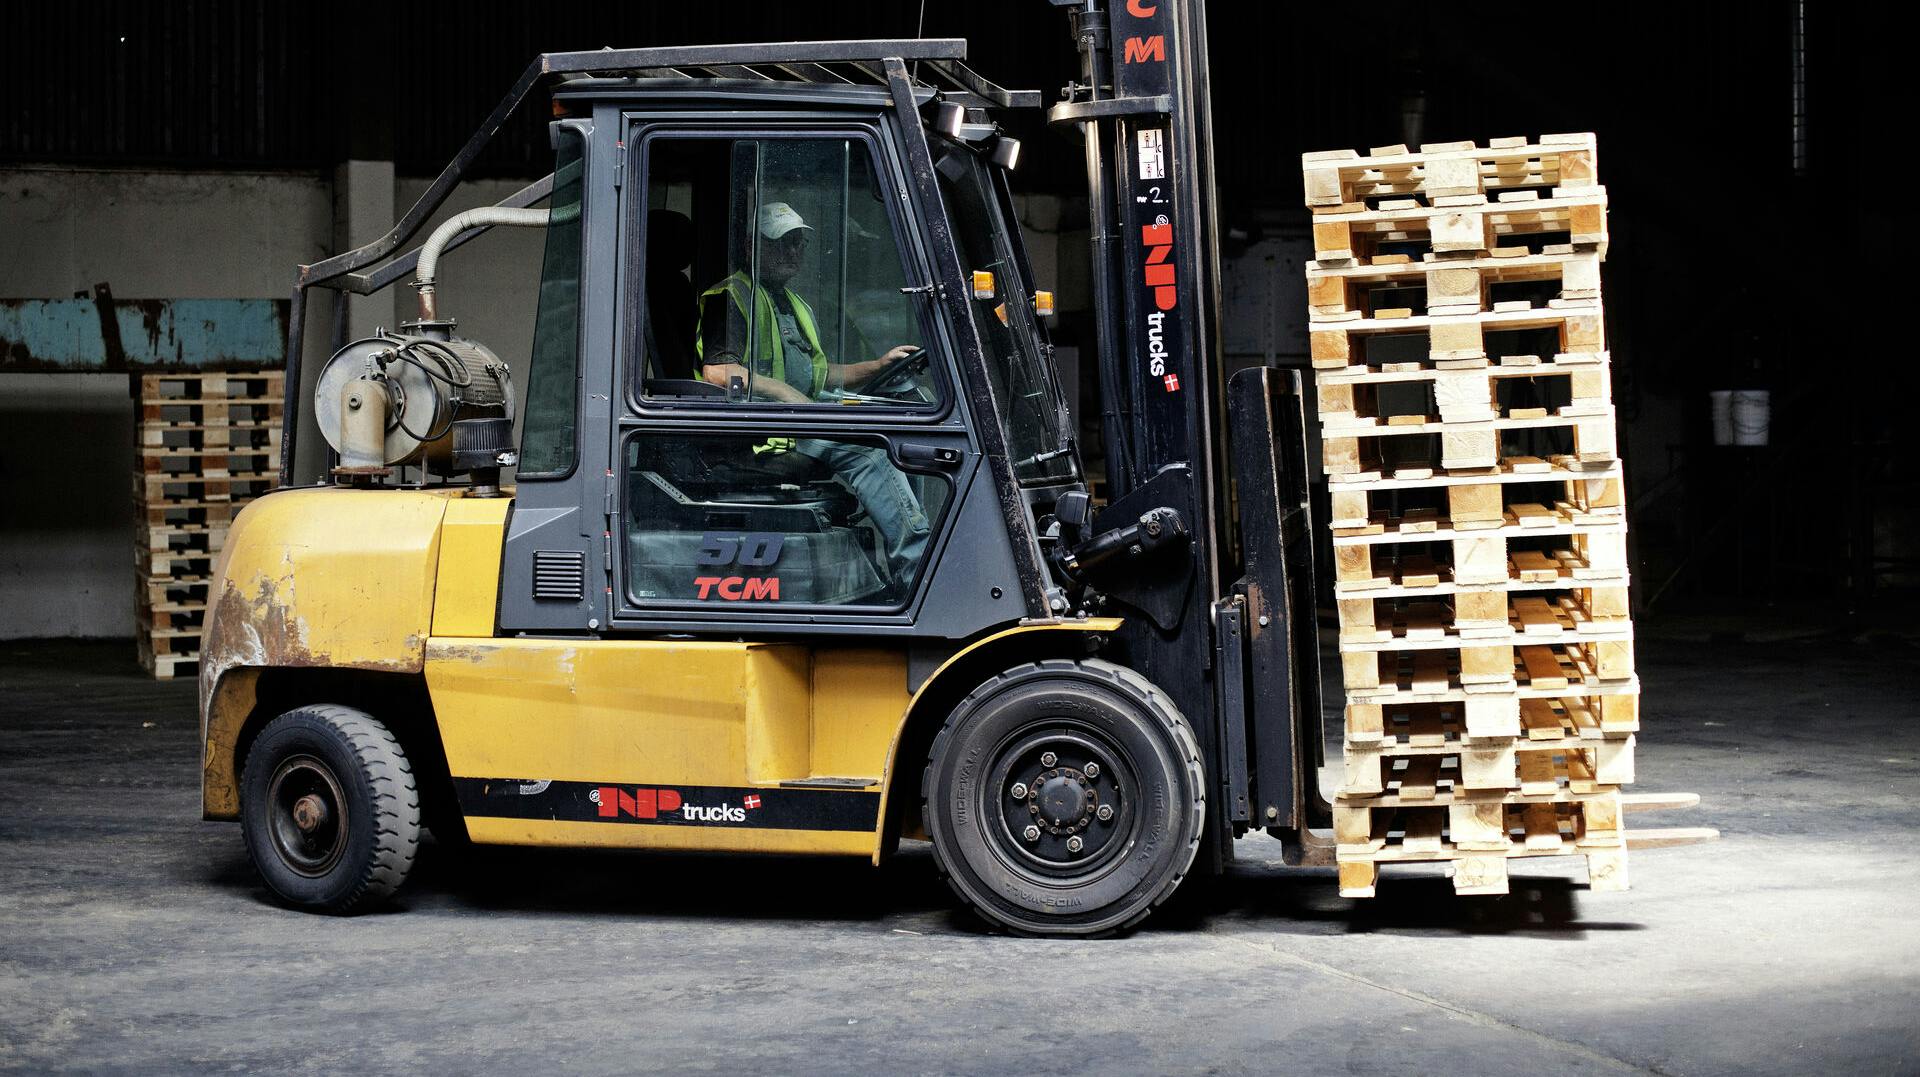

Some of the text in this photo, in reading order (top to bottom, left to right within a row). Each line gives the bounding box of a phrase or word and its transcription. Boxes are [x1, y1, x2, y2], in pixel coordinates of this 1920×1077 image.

[1147, 311, 1168, 377] trucks
[699, 531, 785, 567] 50
[694, 576, 780, 600] TCM
[682, 803, 746, 822] trucks
